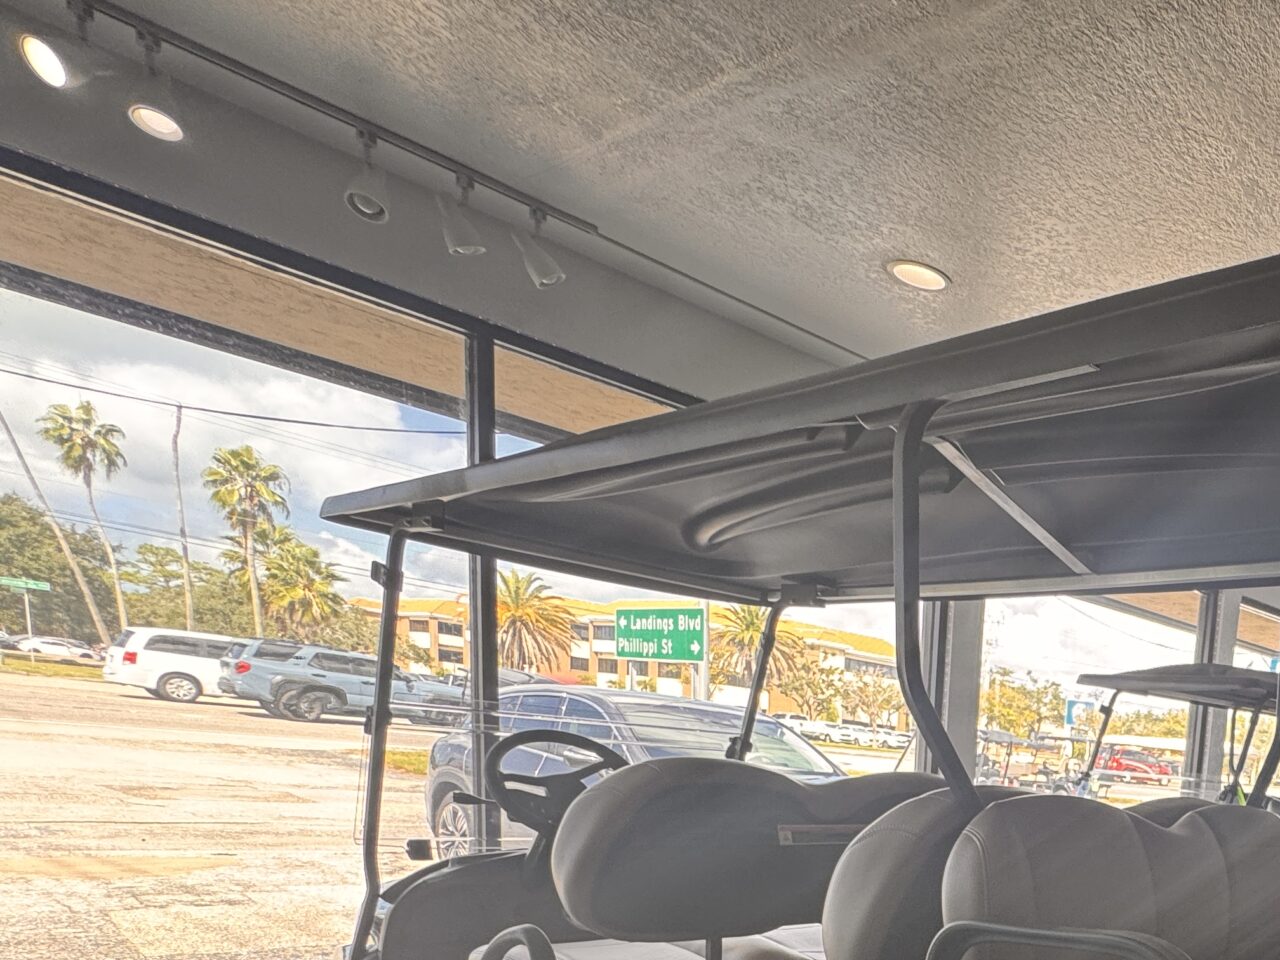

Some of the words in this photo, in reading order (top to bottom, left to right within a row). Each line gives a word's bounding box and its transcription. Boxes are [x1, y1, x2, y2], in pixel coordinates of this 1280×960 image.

[630, 614, 674, 635] Landings
[678, 614, 701, 631] Blvd
[618, 637, 657, 657] Phillippi
[661, 638, 673, 655] St
